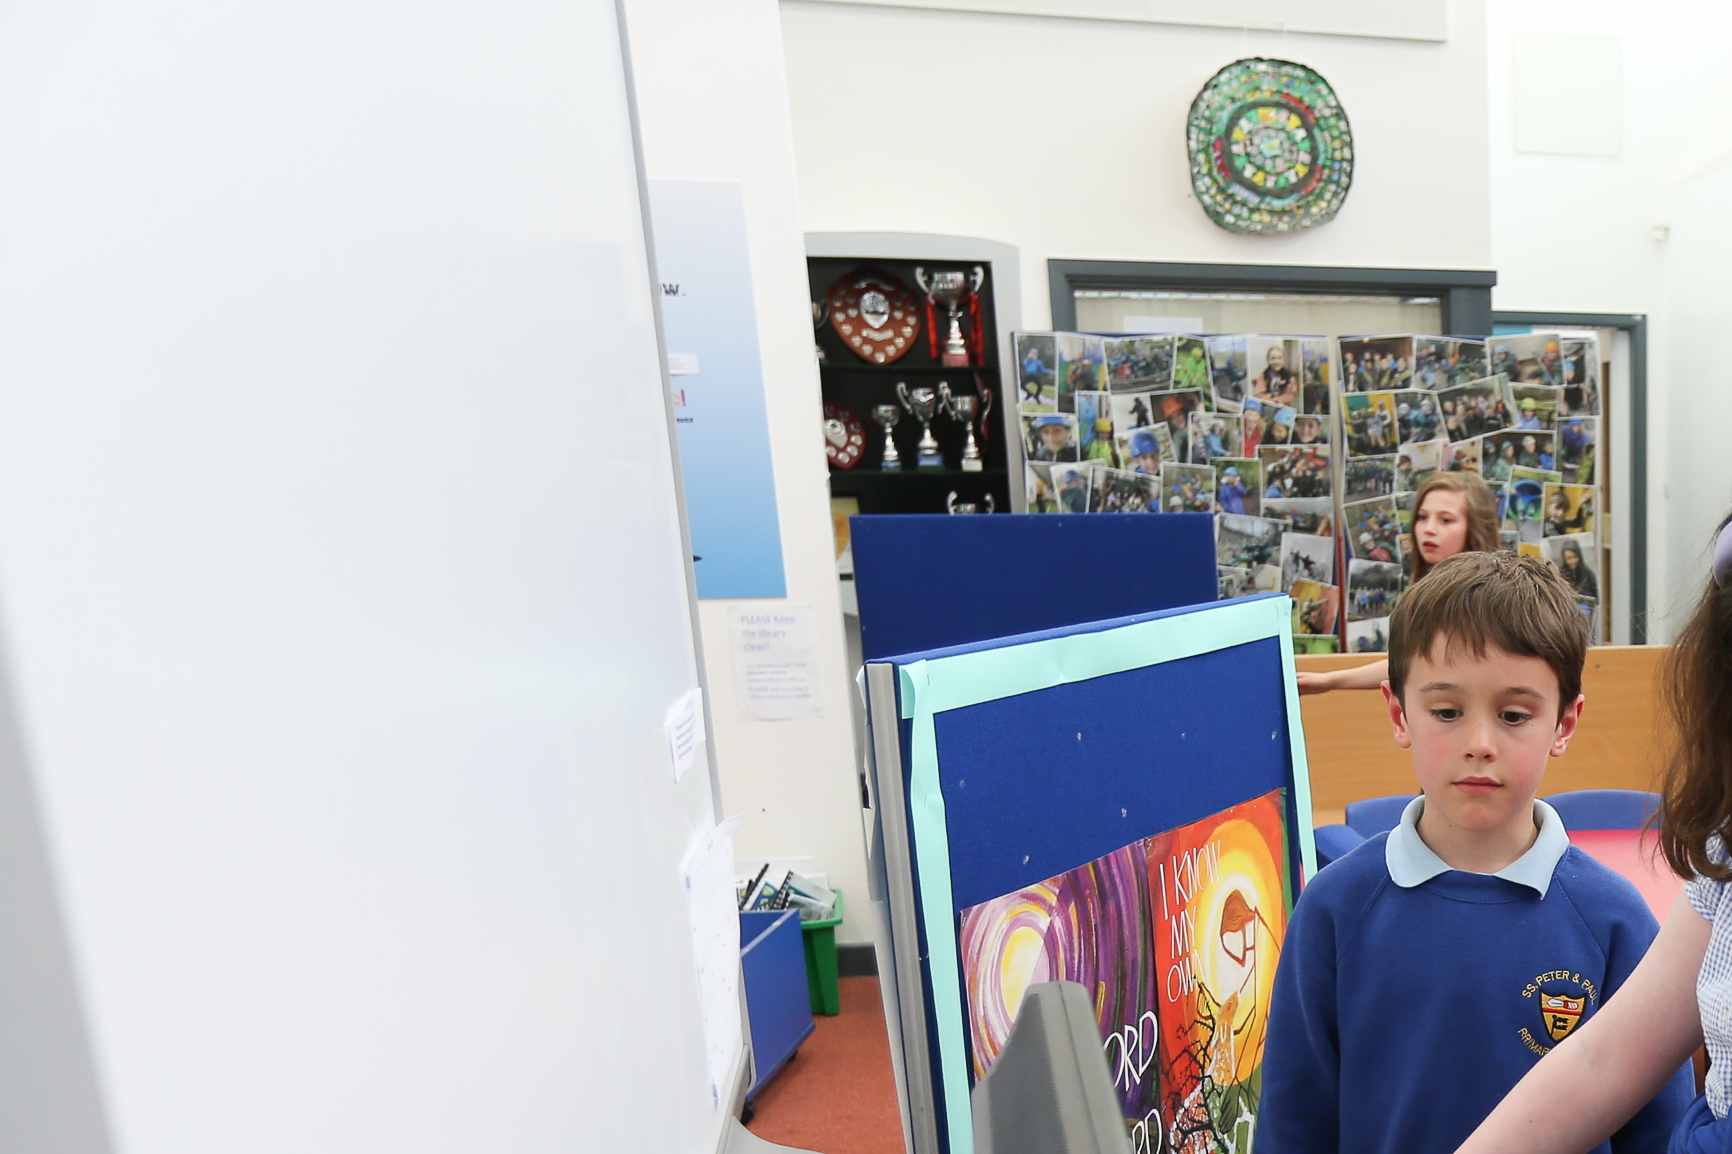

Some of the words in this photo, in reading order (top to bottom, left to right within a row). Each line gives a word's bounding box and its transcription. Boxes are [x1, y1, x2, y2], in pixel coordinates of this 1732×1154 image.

[1159, 863, 1169, 921] I
[1173, 839, 1222, 906] KNOW
[1171, 905, 1198, 960] MY
[1167, 947, 1206, 1003] OWN
[1535, 970, 1571, 987] PETER
[1572, 973, 1581, 984] &
[1581, 979, 1599, 1005] PAUL
[1103, 1010, 1159, 1092] ORD
[1517, 1027, 1551, 1056] PRIMAR
